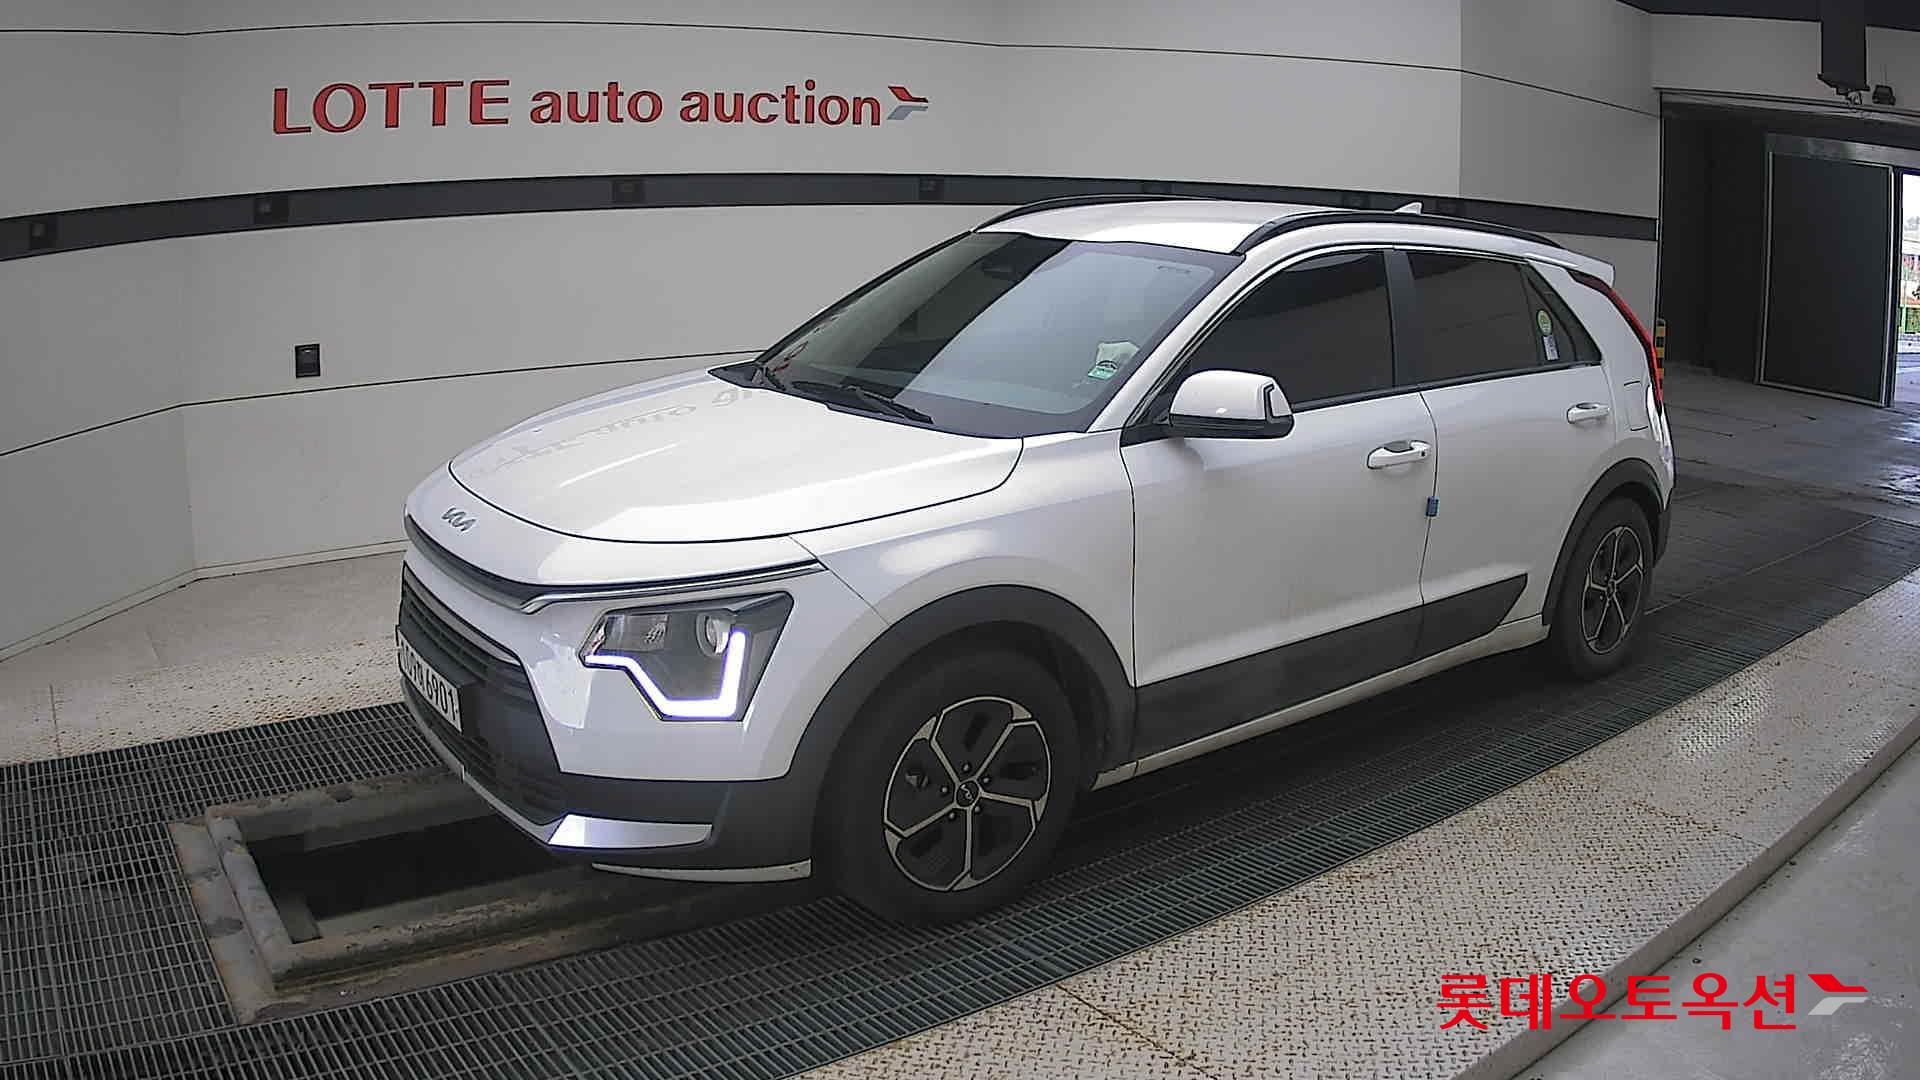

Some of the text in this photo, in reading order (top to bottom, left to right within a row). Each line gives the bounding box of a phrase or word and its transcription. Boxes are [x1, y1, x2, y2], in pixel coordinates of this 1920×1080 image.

[273, 79, 881, 134] LOTTE auto auction
